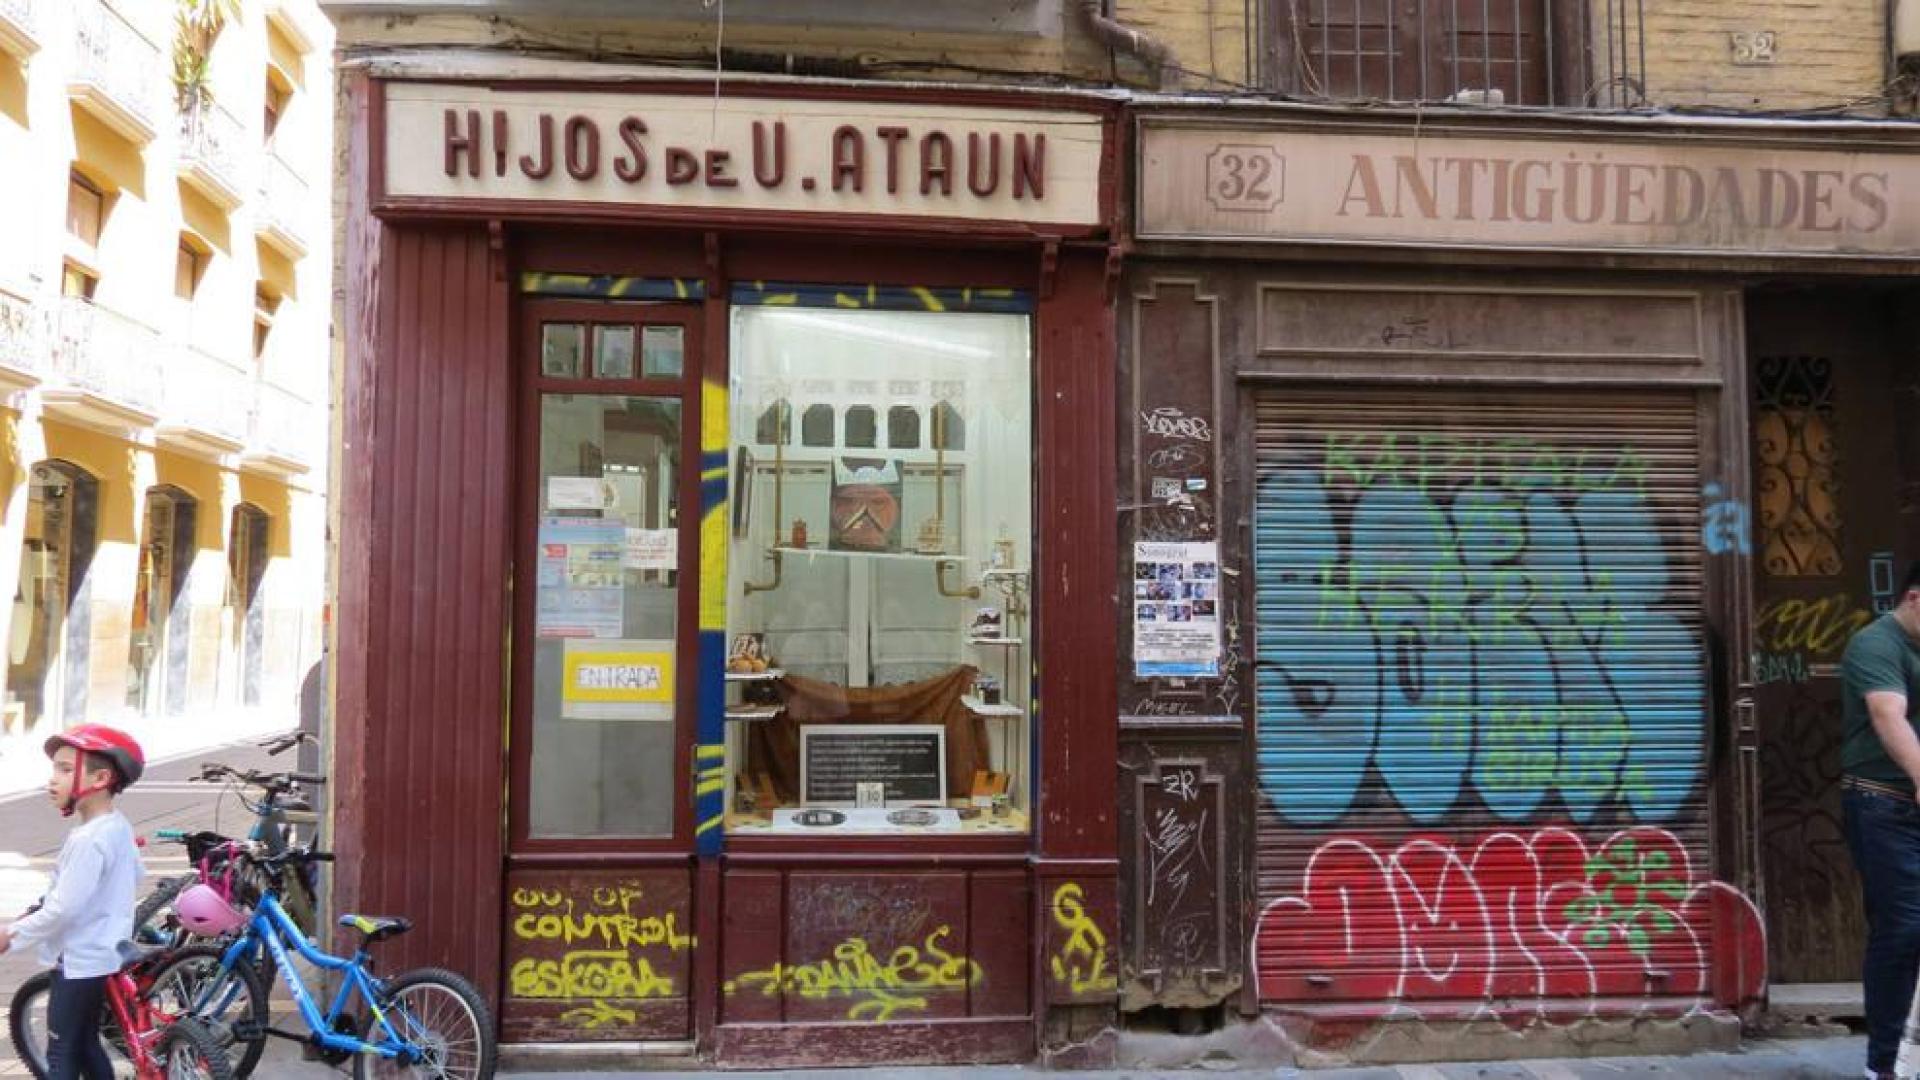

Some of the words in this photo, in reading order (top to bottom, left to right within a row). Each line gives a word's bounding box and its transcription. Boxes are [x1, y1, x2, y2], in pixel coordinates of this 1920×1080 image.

[444, 109, 648, 183] HIJOS
[831, 124, 1046, 199] ATAUN
[1218, 154, 1273, 201] 32
[1334, 151, 1890, 234] ANTIGÜEDADES
[577, 664, 662, 689] ENTRADA
[513, 911, 698, 950] CONTROL
